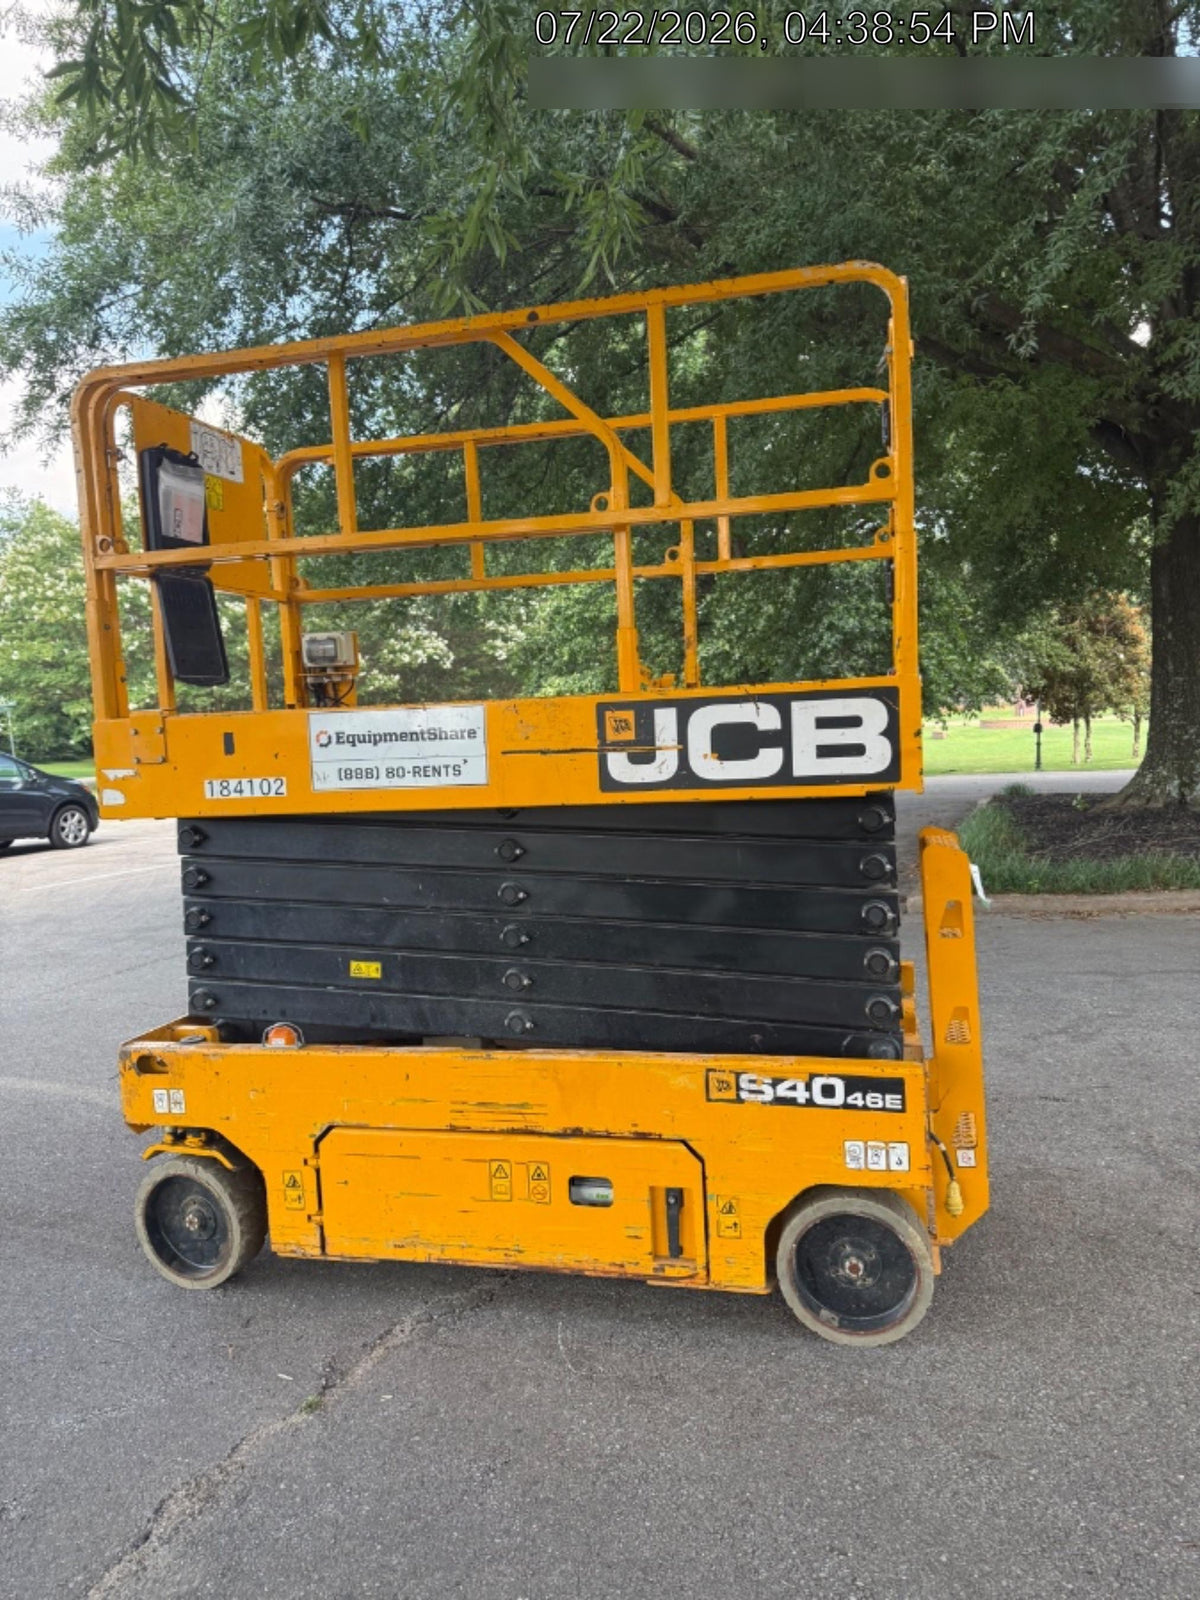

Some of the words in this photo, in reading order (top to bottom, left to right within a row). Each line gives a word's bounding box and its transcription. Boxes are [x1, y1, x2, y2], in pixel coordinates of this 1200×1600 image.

[335, 727, 478, 748] EquipmentShare
[607, 697, 893, 784] JCB
[385, 764, 462, 779] 80-RENTS
[207, 778, 285, 797] 184102
